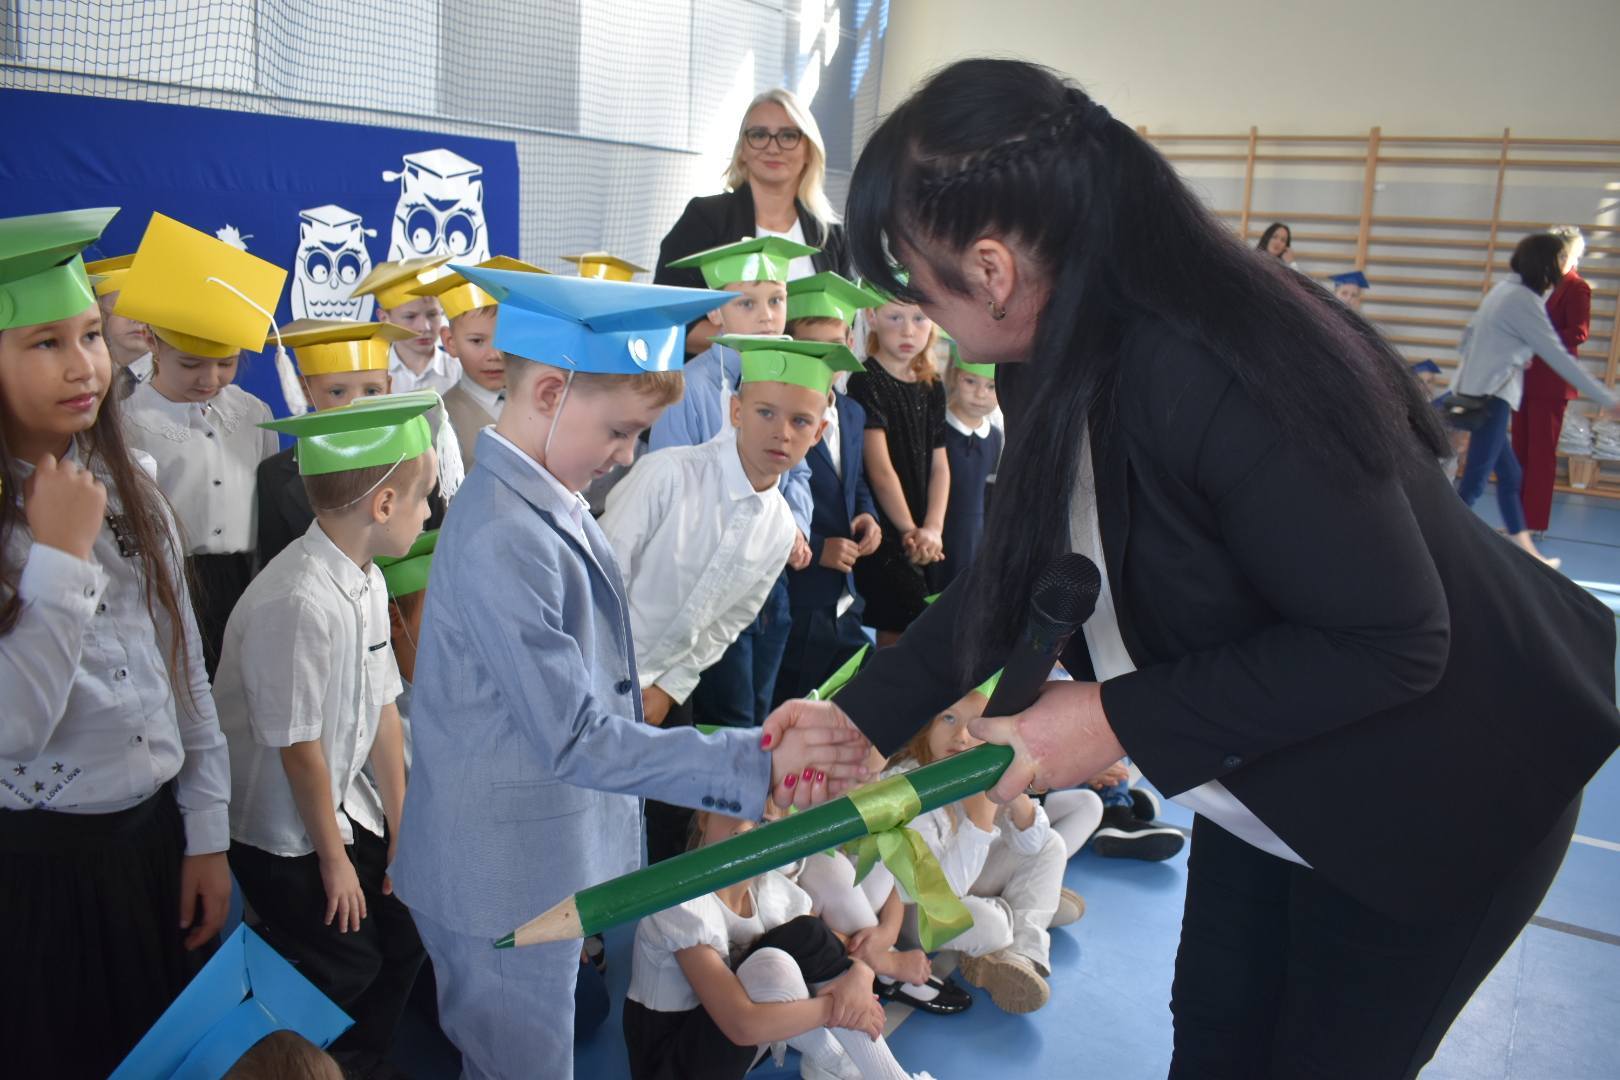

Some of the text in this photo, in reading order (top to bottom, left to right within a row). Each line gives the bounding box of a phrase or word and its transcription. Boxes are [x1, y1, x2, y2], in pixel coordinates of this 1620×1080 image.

[0, 778, 33, 803] OVE LOVE
[46, 768, 81, 800] LOVE LOVE
